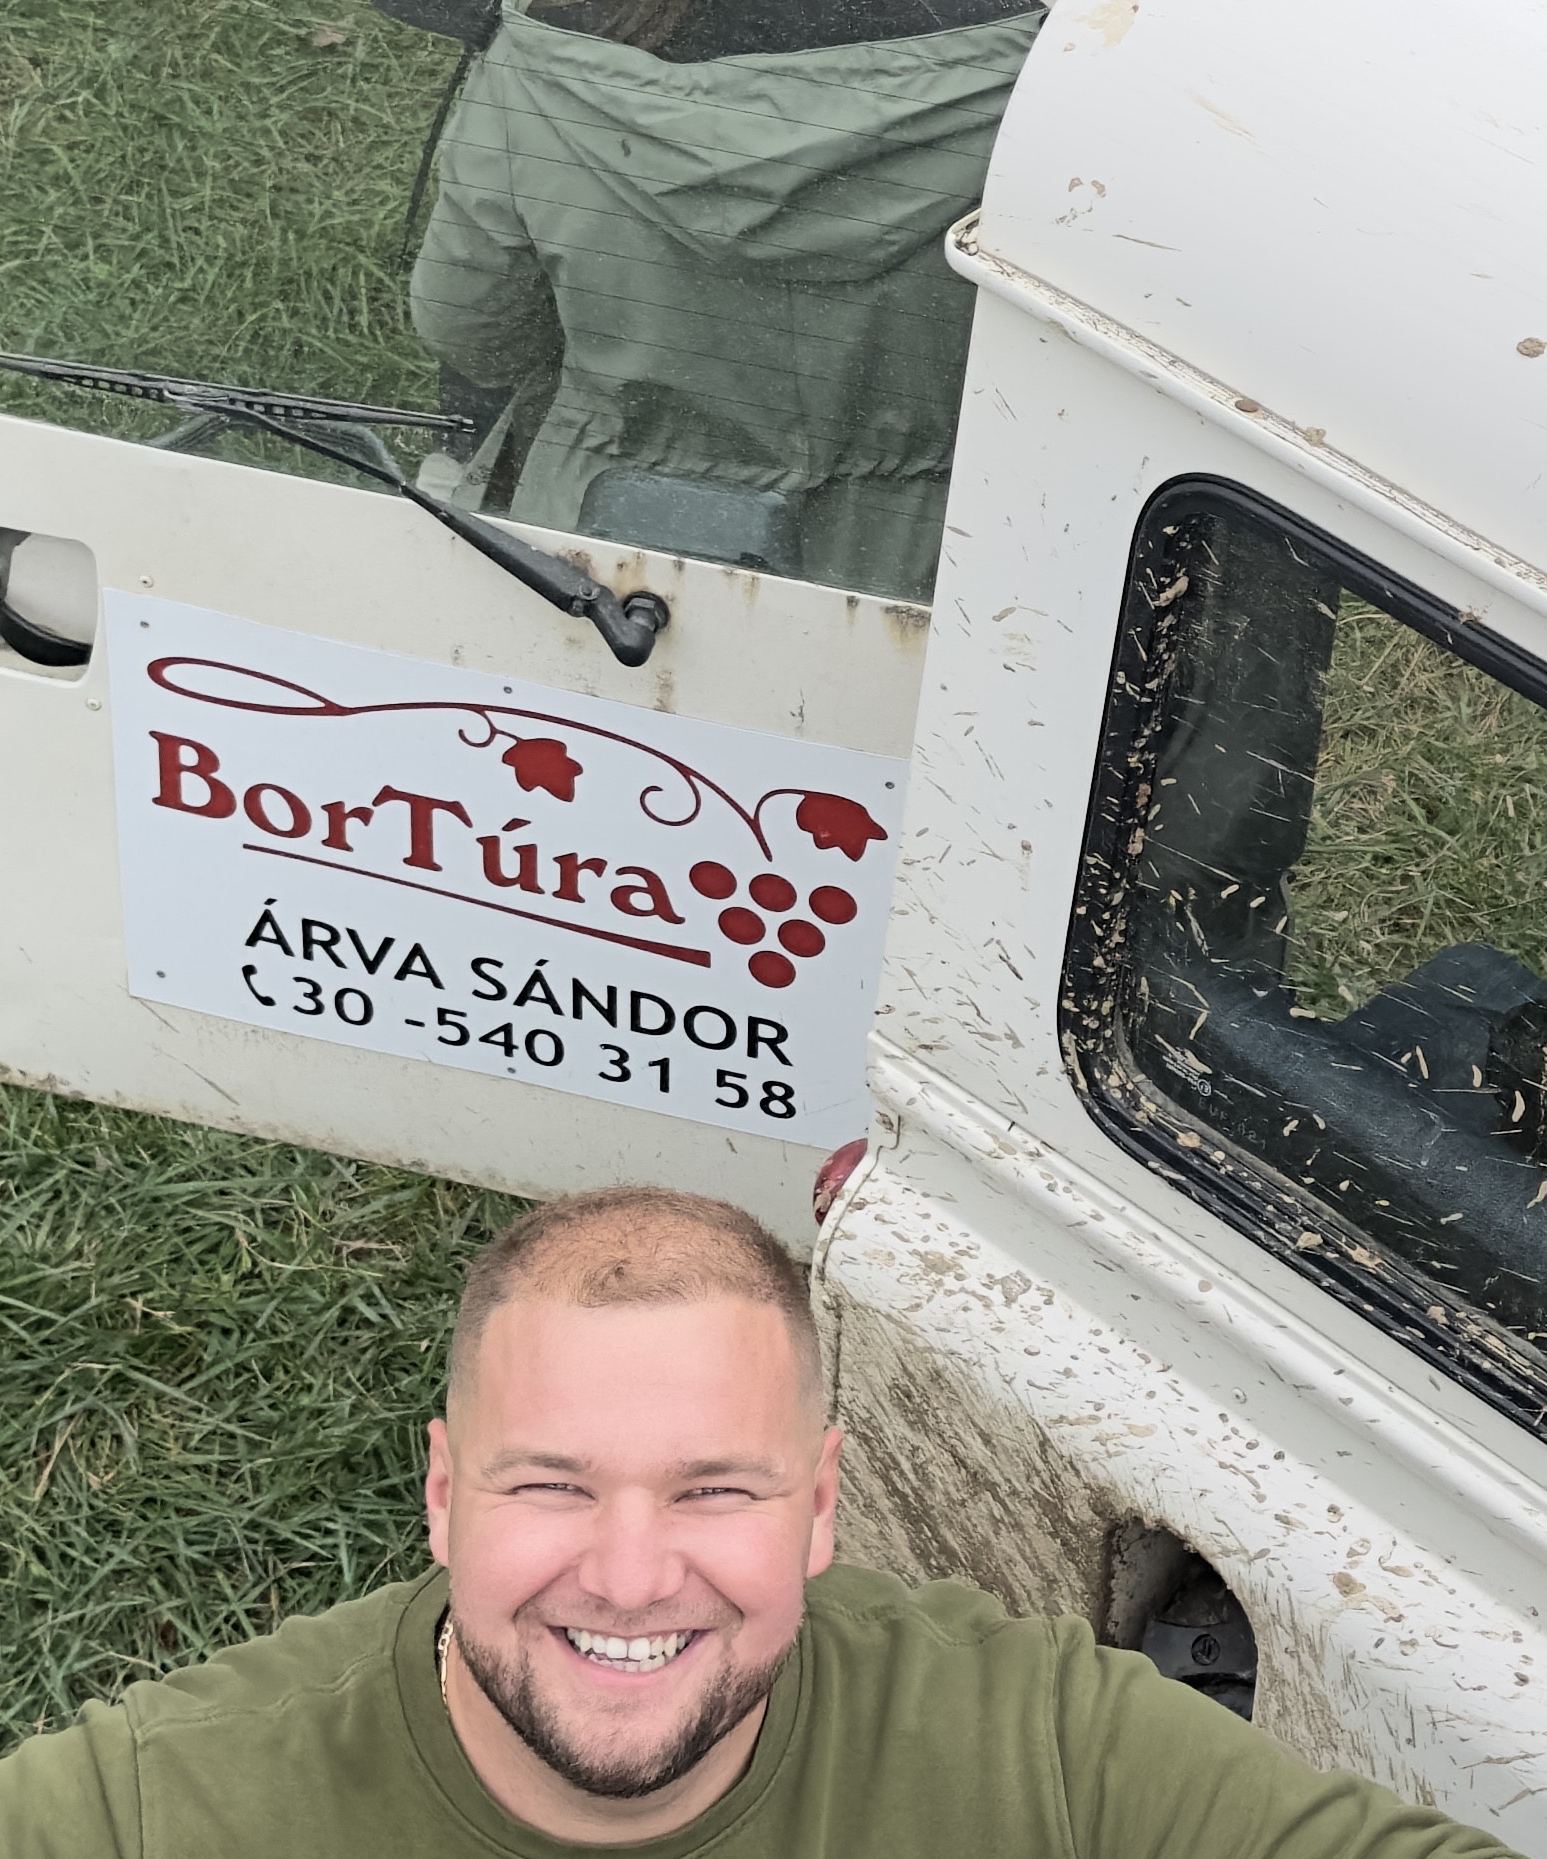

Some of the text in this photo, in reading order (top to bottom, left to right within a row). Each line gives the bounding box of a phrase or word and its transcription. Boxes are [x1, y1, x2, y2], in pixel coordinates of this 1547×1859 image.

[148, 730, 686, 925] BorTúra
[244, 898, 795, 1067] ÁRVA SÁNDOR
[292, 976, 798, 1120] 30 -540 31 58
